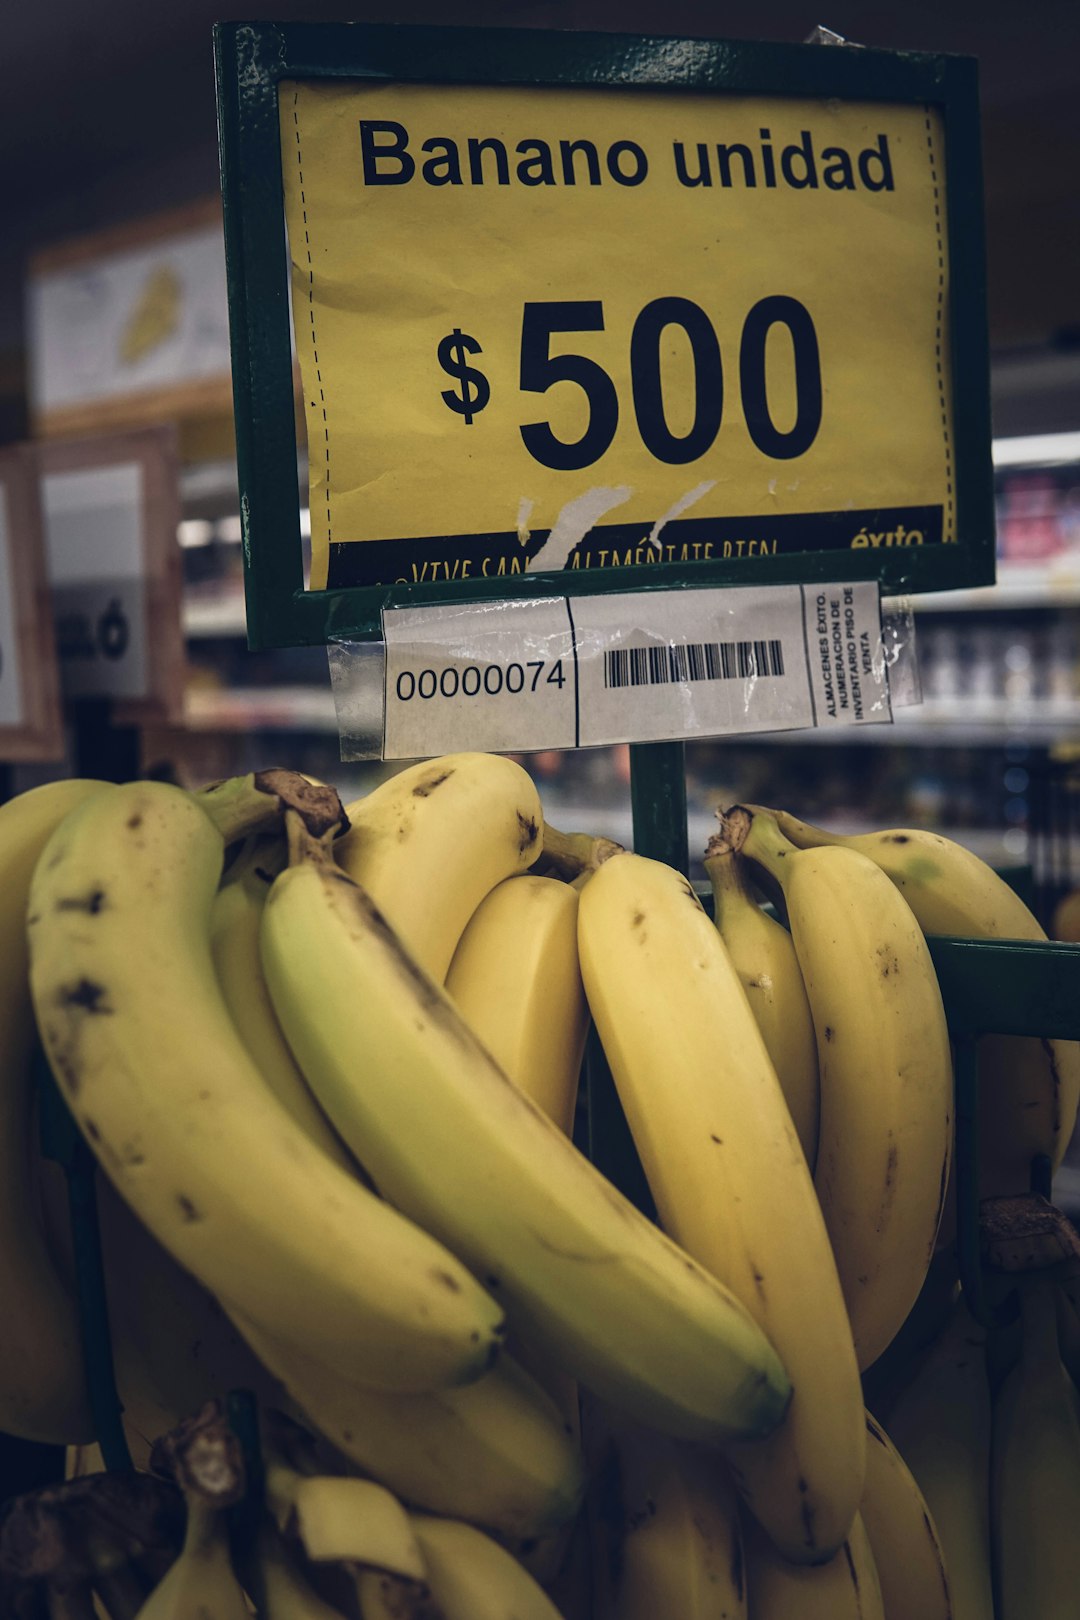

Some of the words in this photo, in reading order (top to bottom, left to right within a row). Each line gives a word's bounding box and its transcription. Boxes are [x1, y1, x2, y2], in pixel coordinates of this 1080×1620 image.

[358, 119, 649, 187] Banano
[674, 128, 896, 193] unidad
[830, 600, 841, 618] DE
[843, 587, 853, 605] DE
[844, 608, 855, 639] PISO
[831, 620, 849, 709] NUMERACION
[860, 632, 872, 675] VENTA
[396, 659, 567, 701] 00000074
[819, 636, 838, 718] ALMACENES
[847, 641, 863, 720] INVENTARIO
